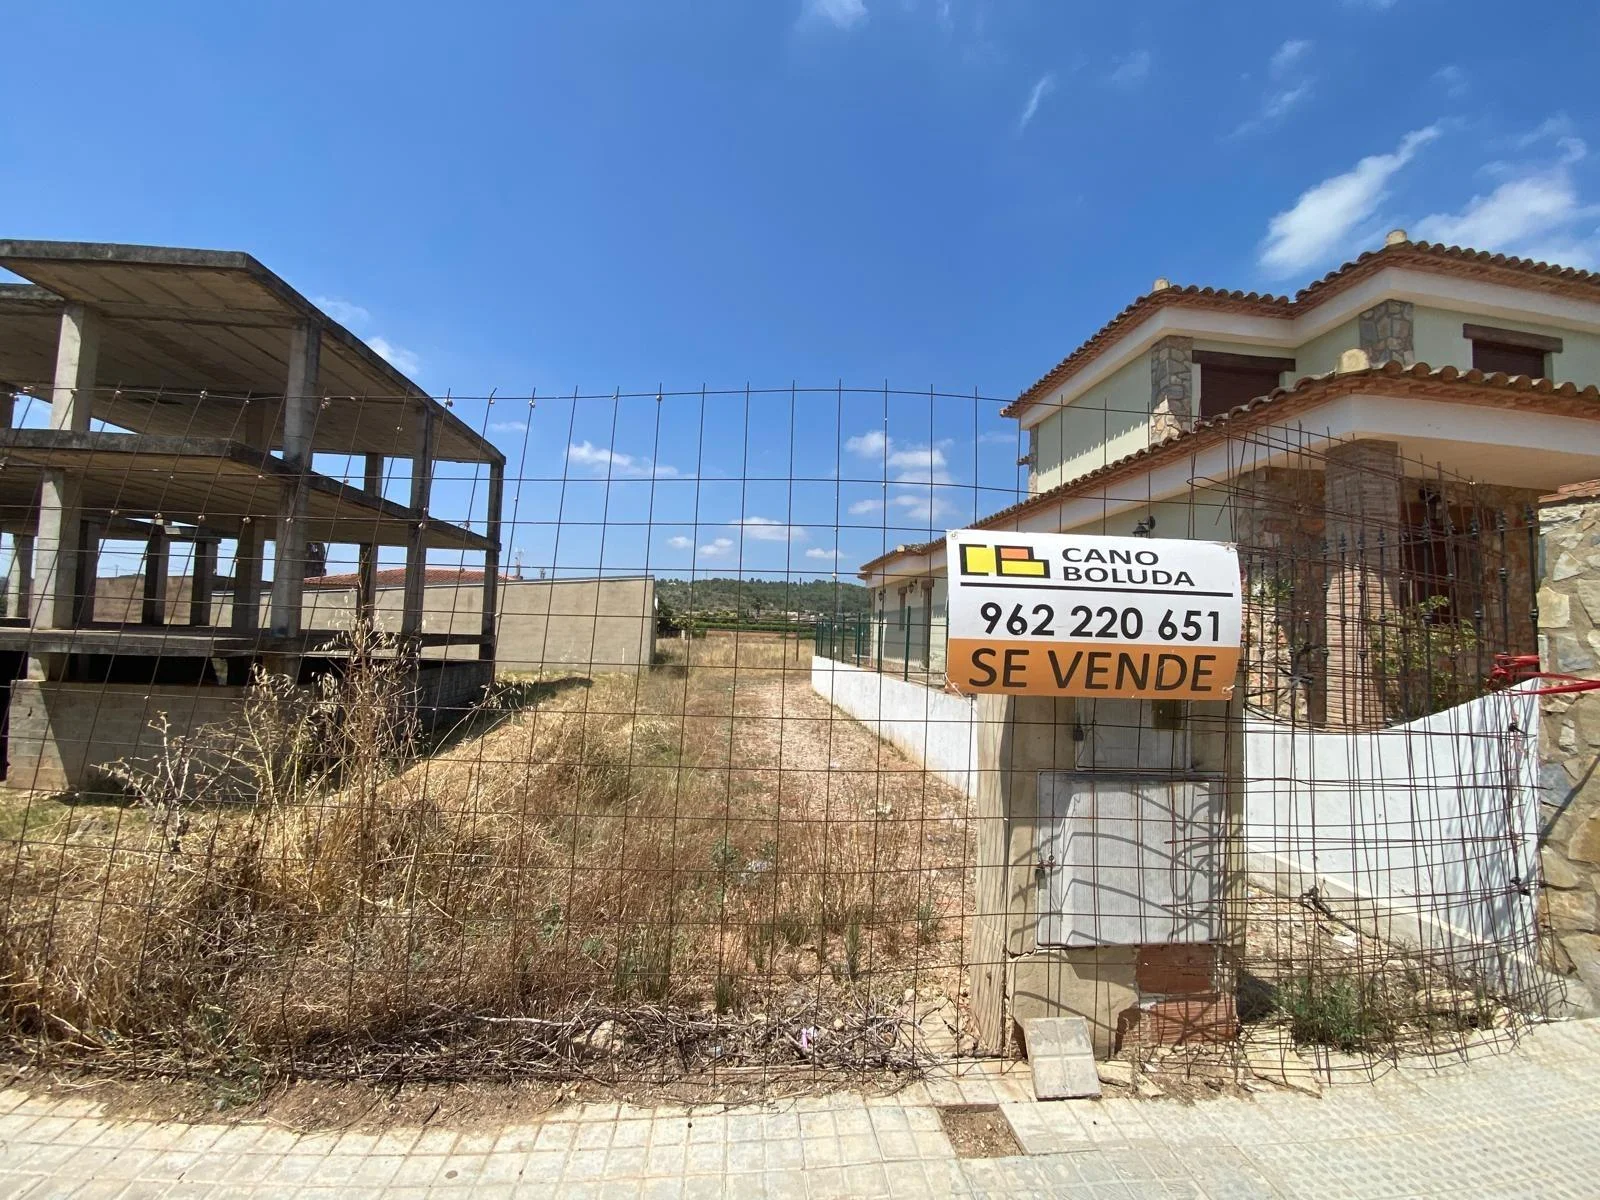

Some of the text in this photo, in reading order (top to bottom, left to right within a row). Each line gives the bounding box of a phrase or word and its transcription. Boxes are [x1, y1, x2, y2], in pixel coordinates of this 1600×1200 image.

[1062, 547, 1159, 566] CANO
[1062, 566, 1196, 587] BOLUDA
[980, 602, 1219, 642] 962 220 651
[968, 647, 1217, 692] SE VENDE
